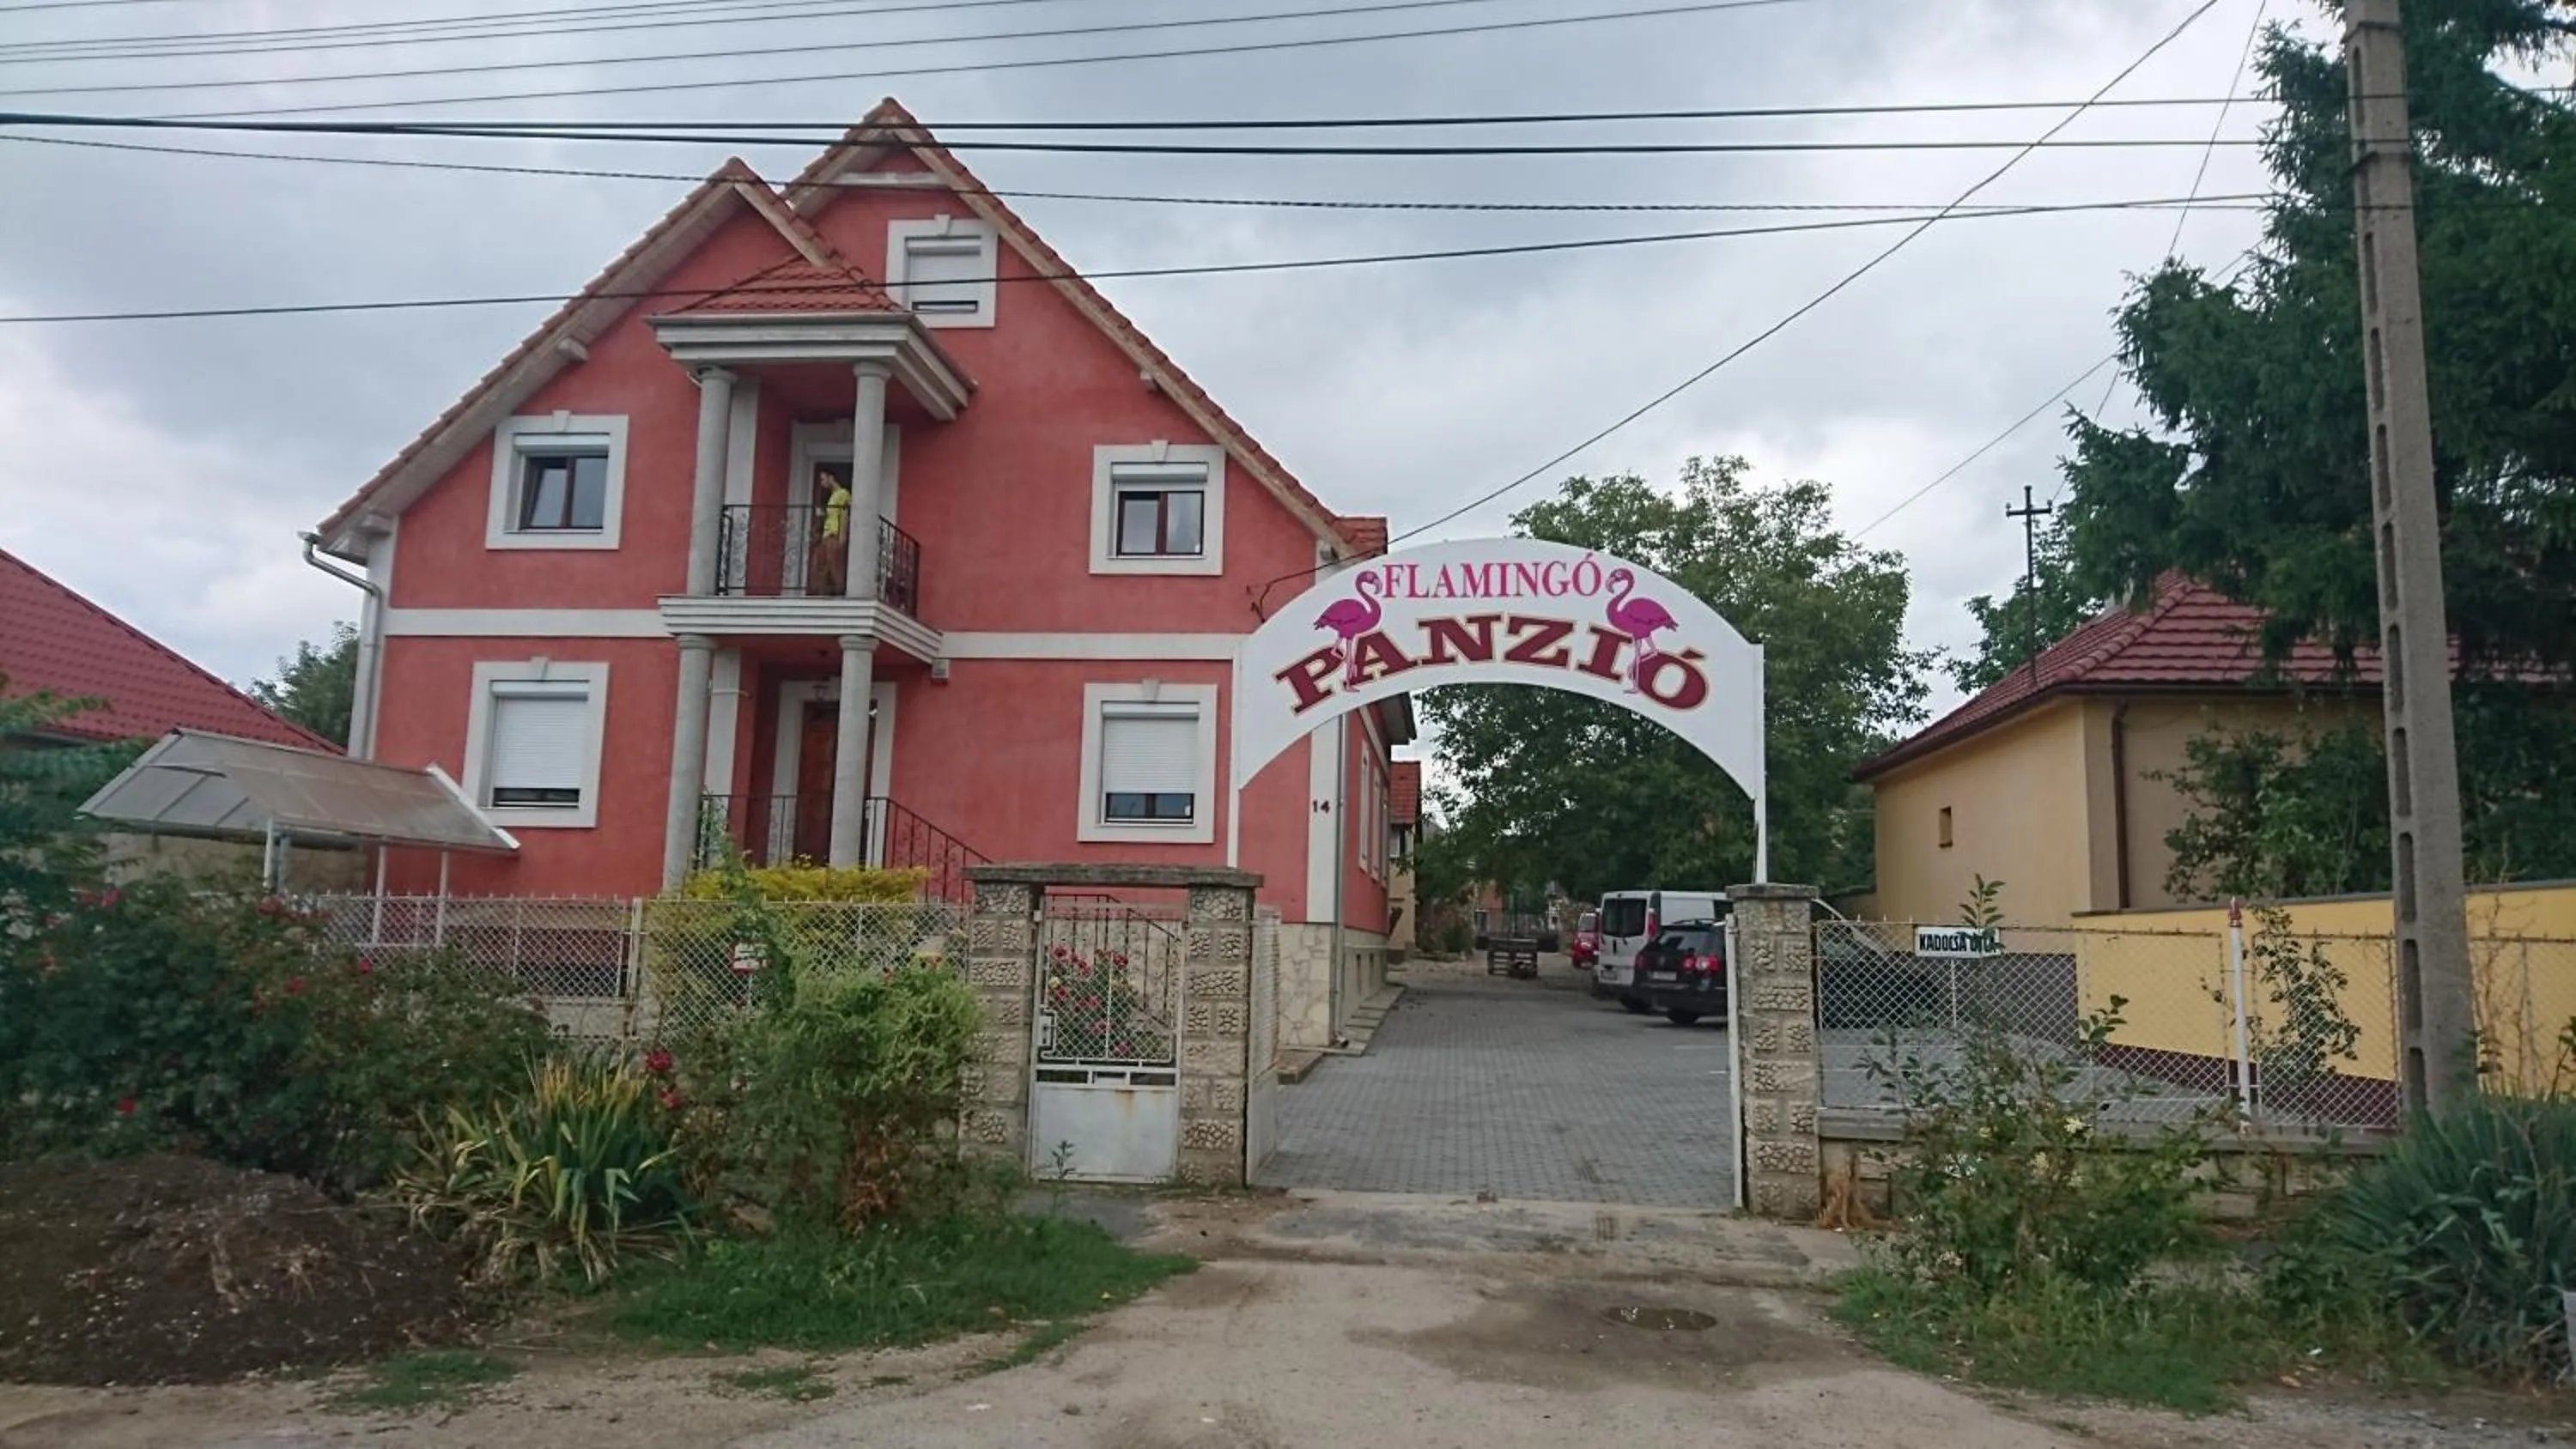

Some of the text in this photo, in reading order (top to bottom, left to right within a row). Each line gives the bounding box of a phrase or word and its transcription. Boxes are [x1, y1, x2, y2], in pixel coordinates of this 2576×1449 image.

[1382, 552, 1602, 599] FLAMINGÓ
[1274, 614, 1709, 712] PANZIÓ
[1313, 800, 1330, 814] 14
[1919, 933, 1967, 952] KADOCSA
